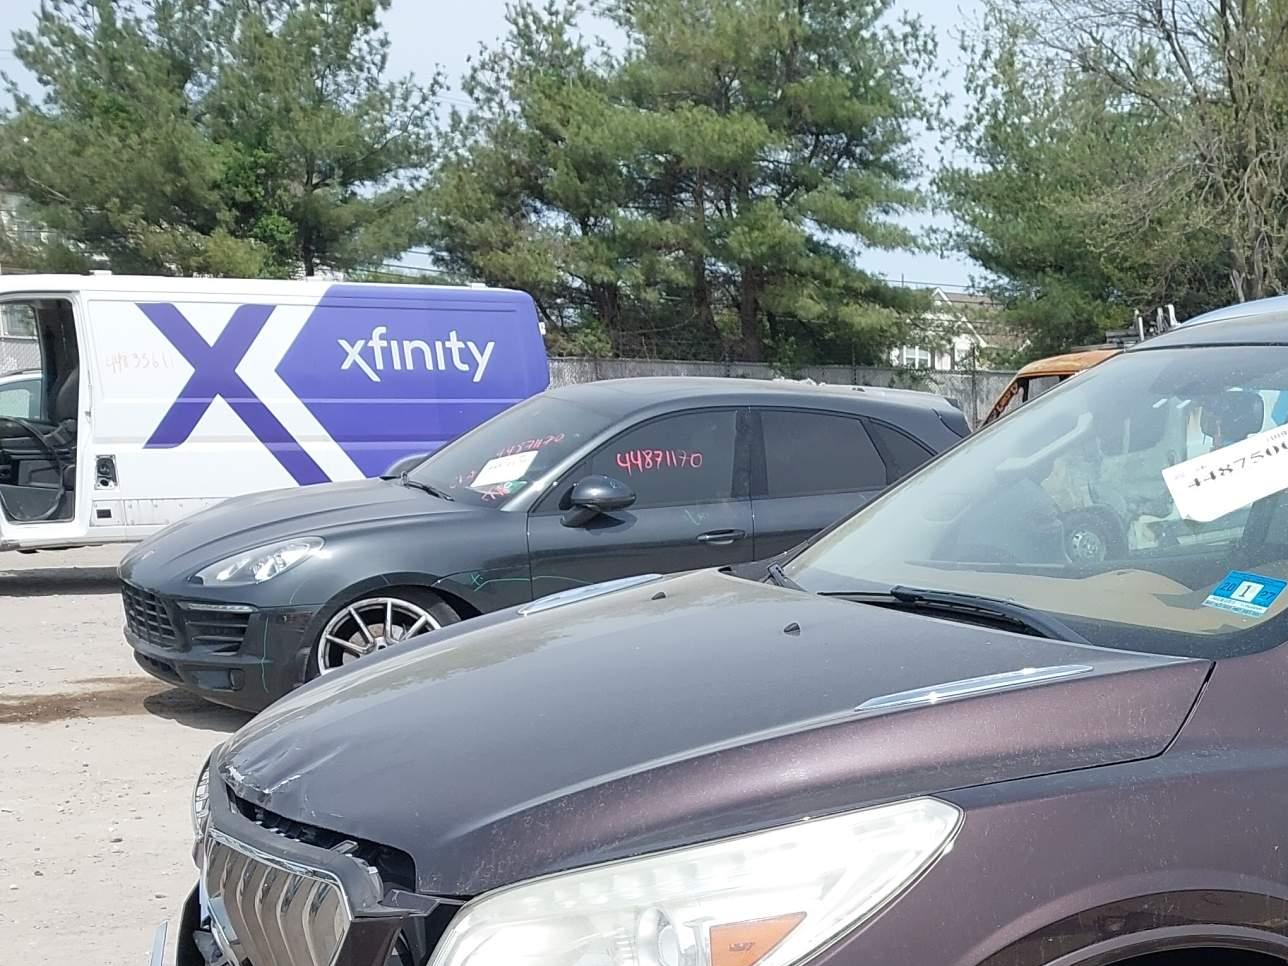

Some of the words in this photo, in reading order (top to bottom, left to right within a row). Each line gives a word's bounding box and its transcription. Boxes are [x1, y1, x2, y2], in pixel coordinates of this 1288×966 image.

[337, 326, 495, 382] xfinity
[616, 449, 703, 477] 44871170
[1239, 584, 1252, 597] 1
